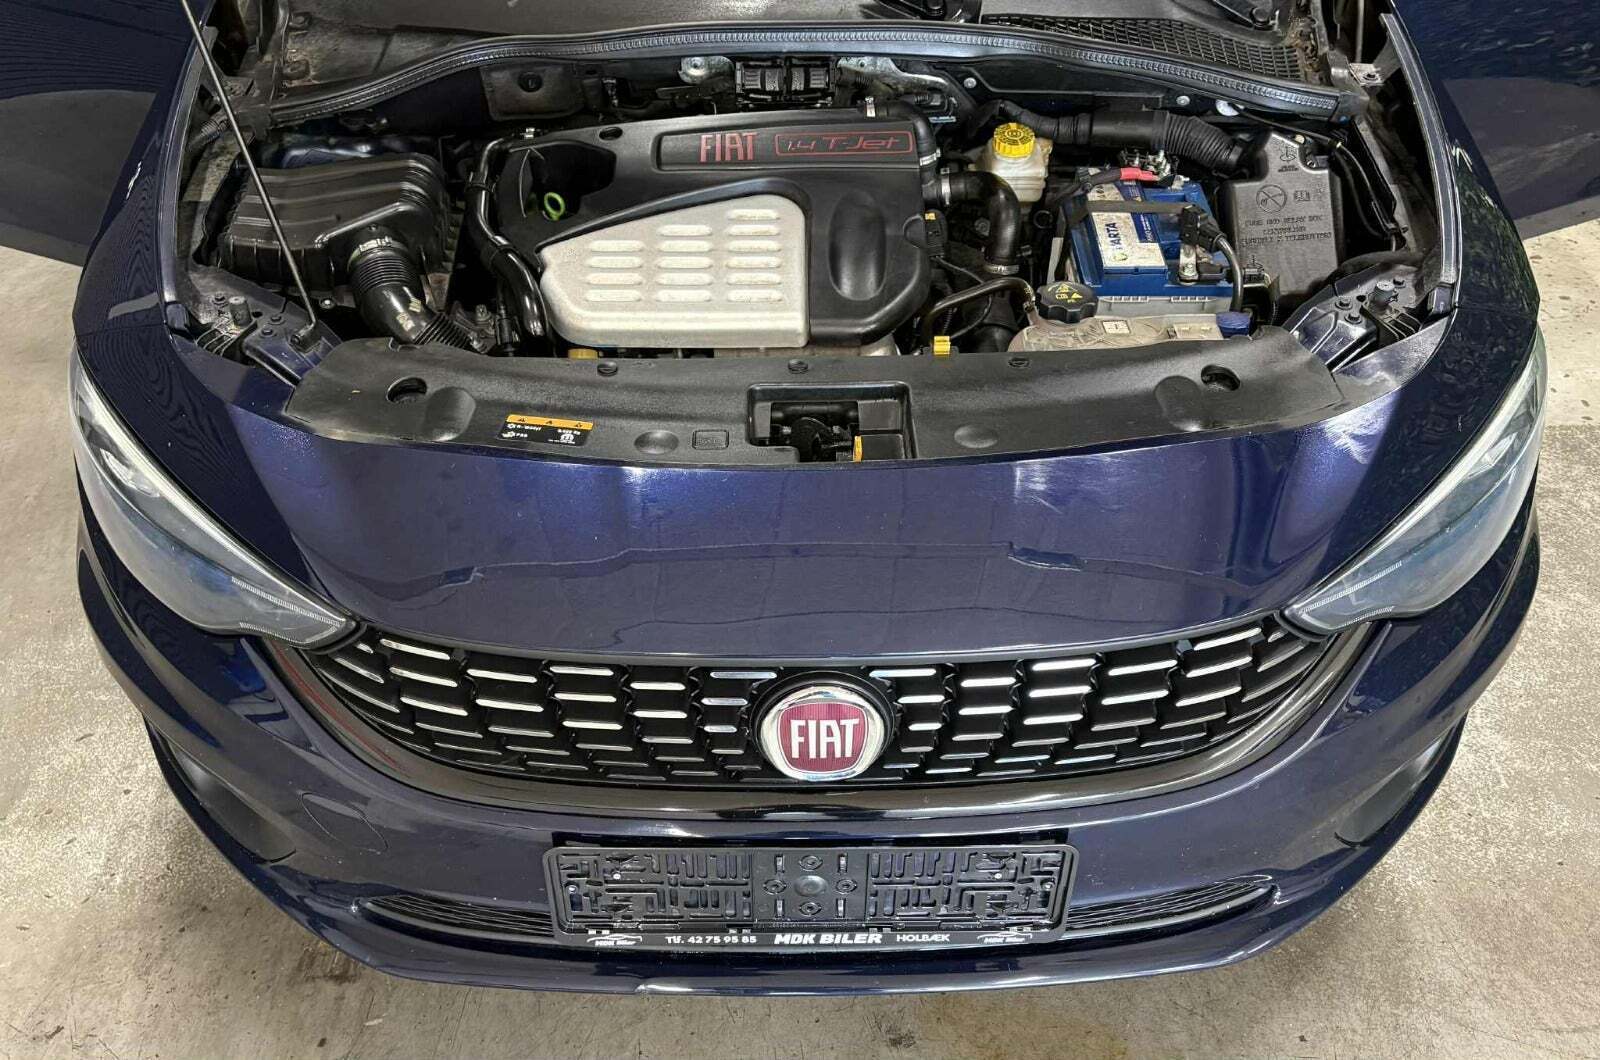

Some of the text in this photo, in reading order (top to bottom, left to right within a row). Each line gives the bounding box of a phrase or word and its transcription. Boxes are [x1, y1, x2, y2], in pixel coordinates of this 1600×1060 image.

[700, 132, 758, 162] FIAT
[787, 136, 899, 151] 1.4 T-Jet
[790, 718, 860, 759] FIAT
[687, 936, 703, 944] 42
[705, 936, 721, 944] 75
[723, 935, 739, 944] 95
[741, 935, 757, 944] 85
[774, 933, 882, 944] MDK BILER
[896, 934, 950, 942] HOLBÆK
